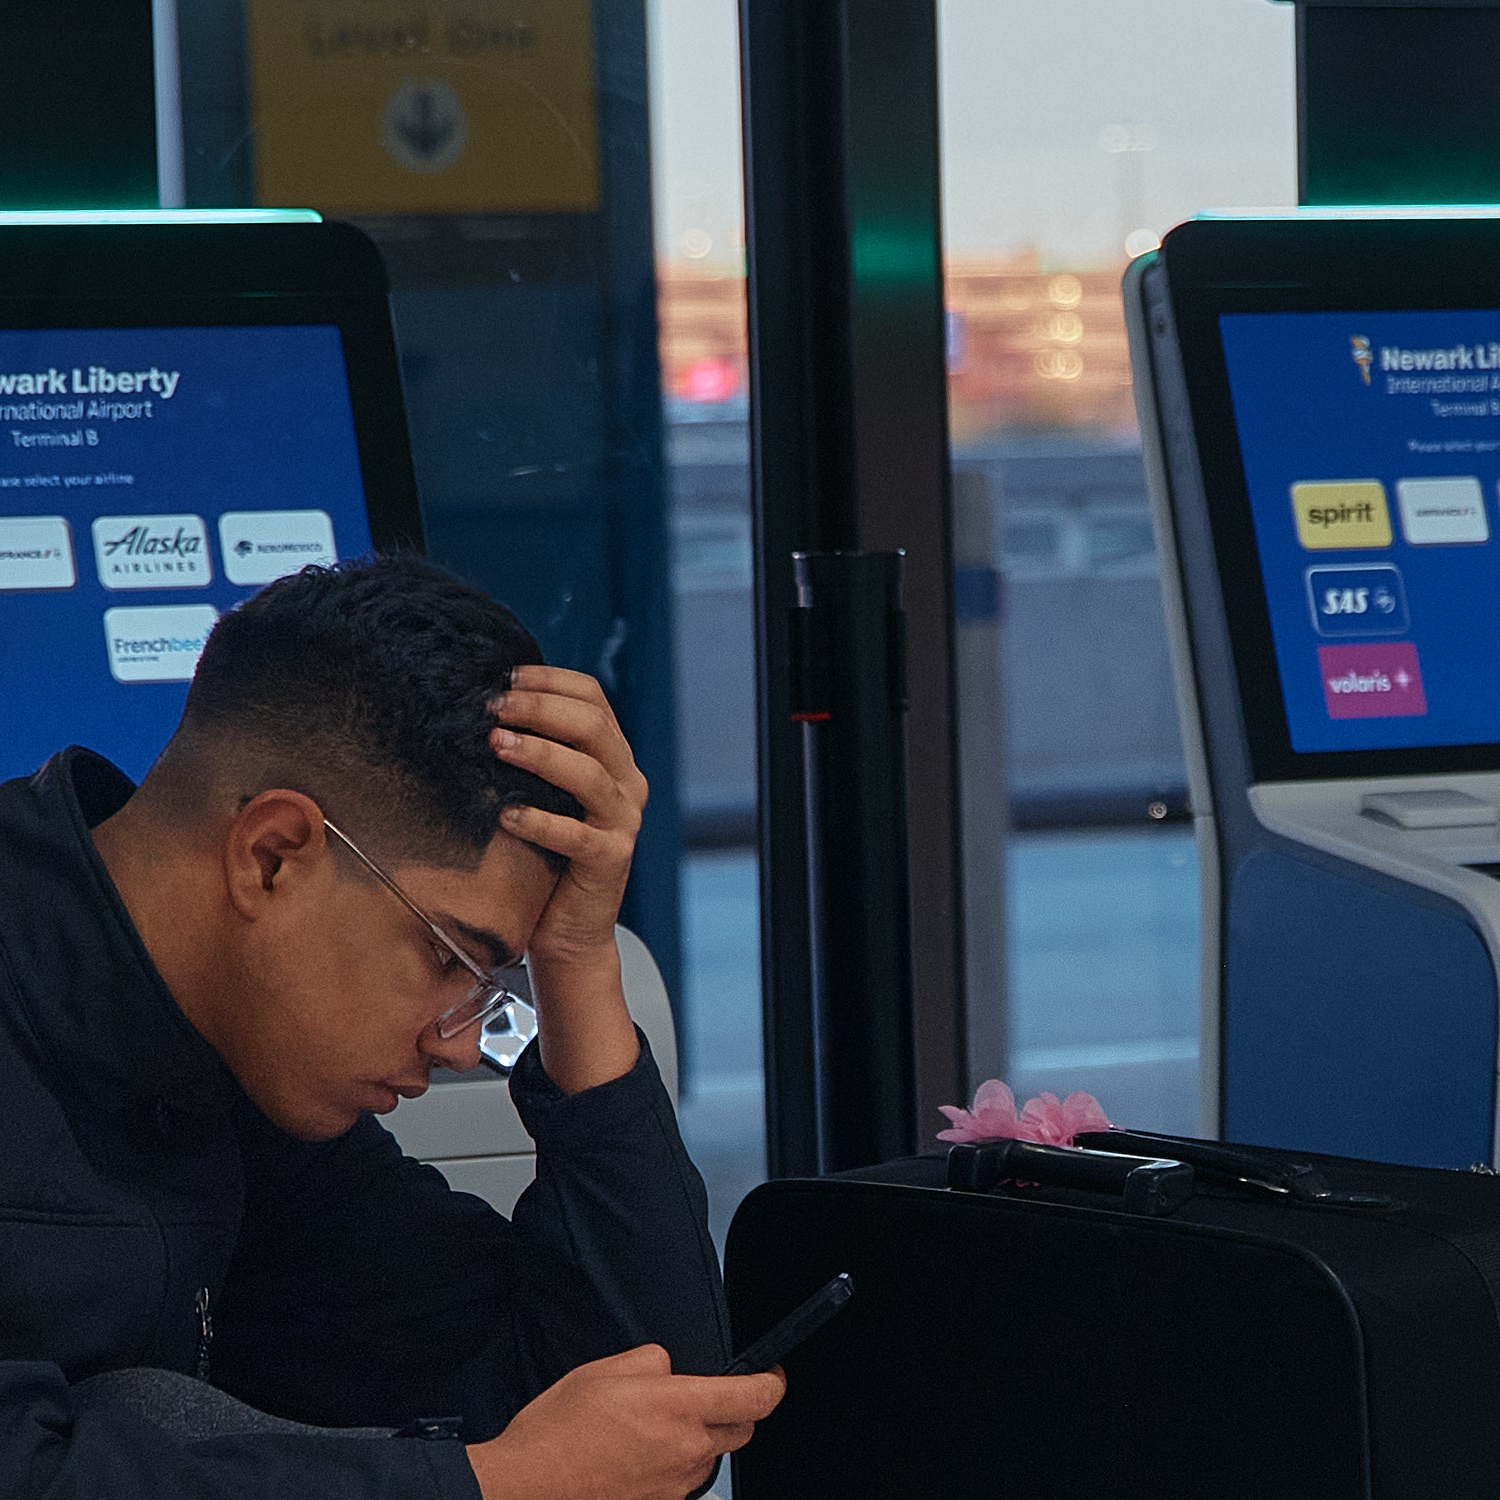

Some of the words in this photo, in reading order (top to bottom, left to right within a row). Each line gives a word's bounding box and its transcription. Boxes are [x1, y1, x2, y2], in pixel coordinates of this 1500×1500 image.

[1381, 343, 1474, 371] Newark
[71, 366, 180, 399] Liberty
[1387, 375, 1489, 394] International
[86, 400, 153, 422] Airport
[10, 429, 83, 447] Terminal
[85, 429, 100, 447] B
[1307, 502, 1376, 529] spirit
[104, 527, 202, 558] Alaska
[112, 562, 197, 574] AIRLINES
[1323, 587, 1370, 615] SAS
[1328, 668, 1392, 693] volaris
